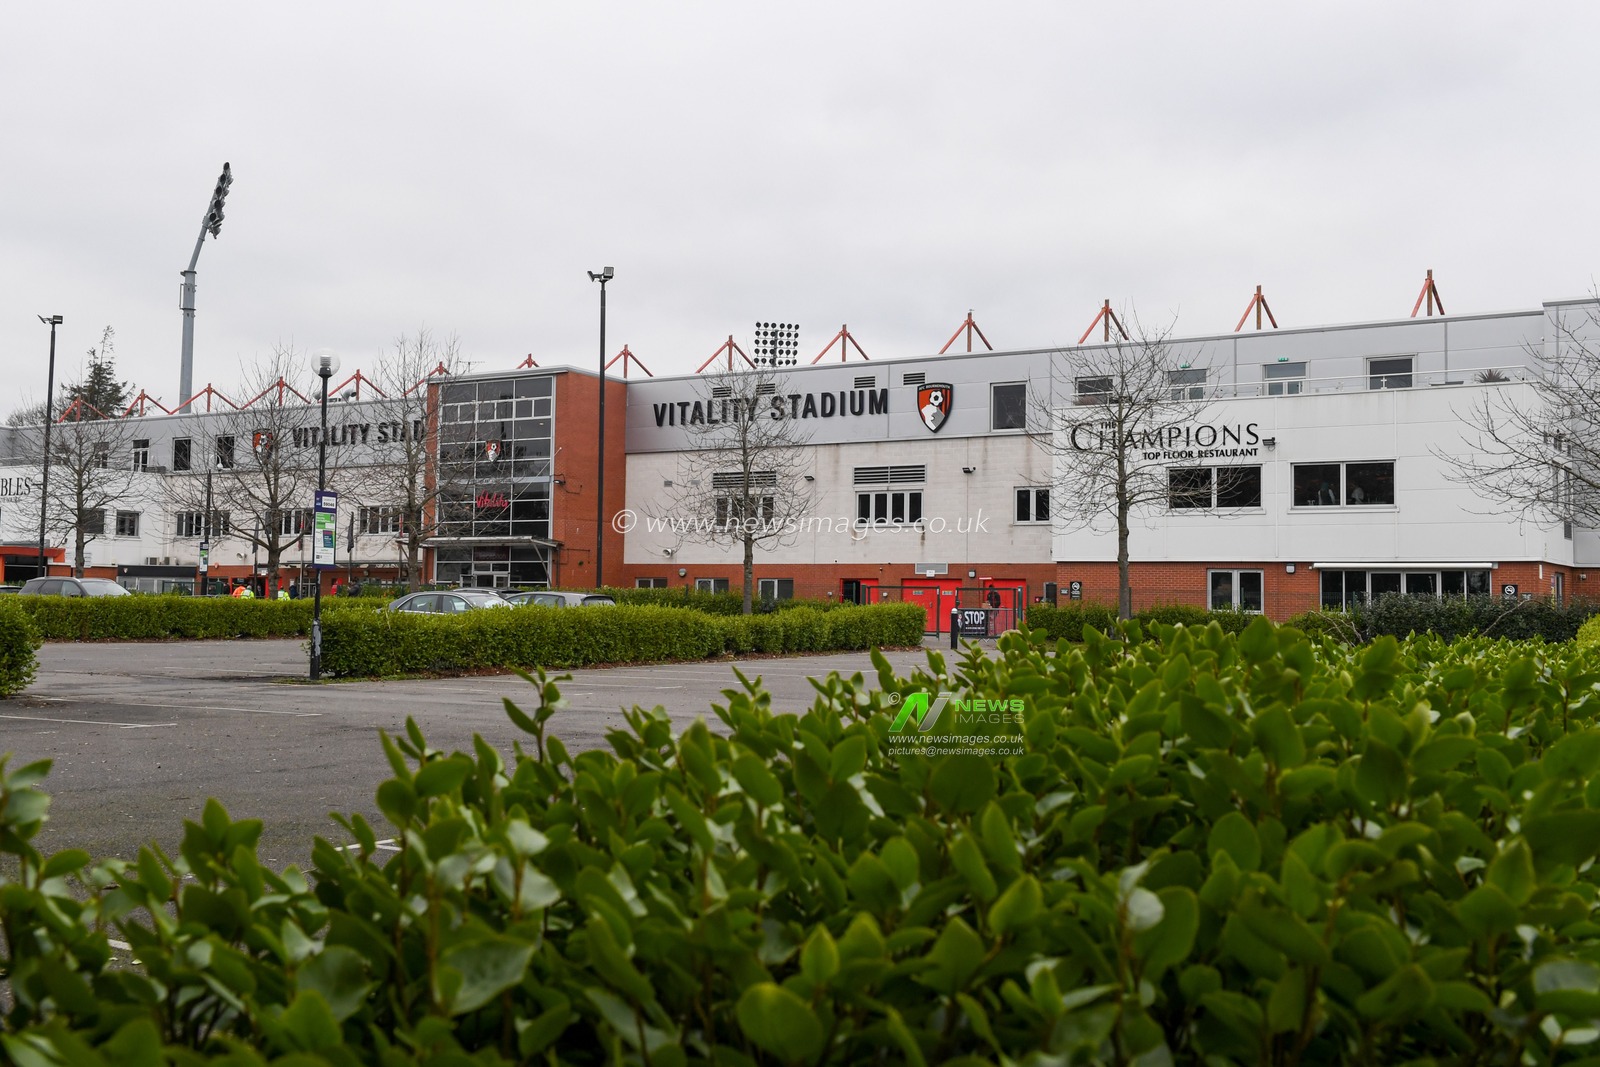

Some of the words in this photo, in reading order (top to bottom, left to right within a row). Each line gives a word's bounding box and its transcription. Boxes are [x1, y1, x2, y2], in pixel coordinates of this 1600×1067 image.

[653, 397, 759, 427] VITALITY
[770, 388, 889, 421] STADIUM
[1100, 421, 1117, 429] THE
[1070, 422, 1259, 451] CHAMPIONS
[1143, 452, 1161, 460] TOP
[1163, 450, 1194, 460] FLOOR
[1198, 448, 1259, 458] RESTAURANT
[1, 476, 31, 496] BLES
[964, 610, 985, 625] STOP
